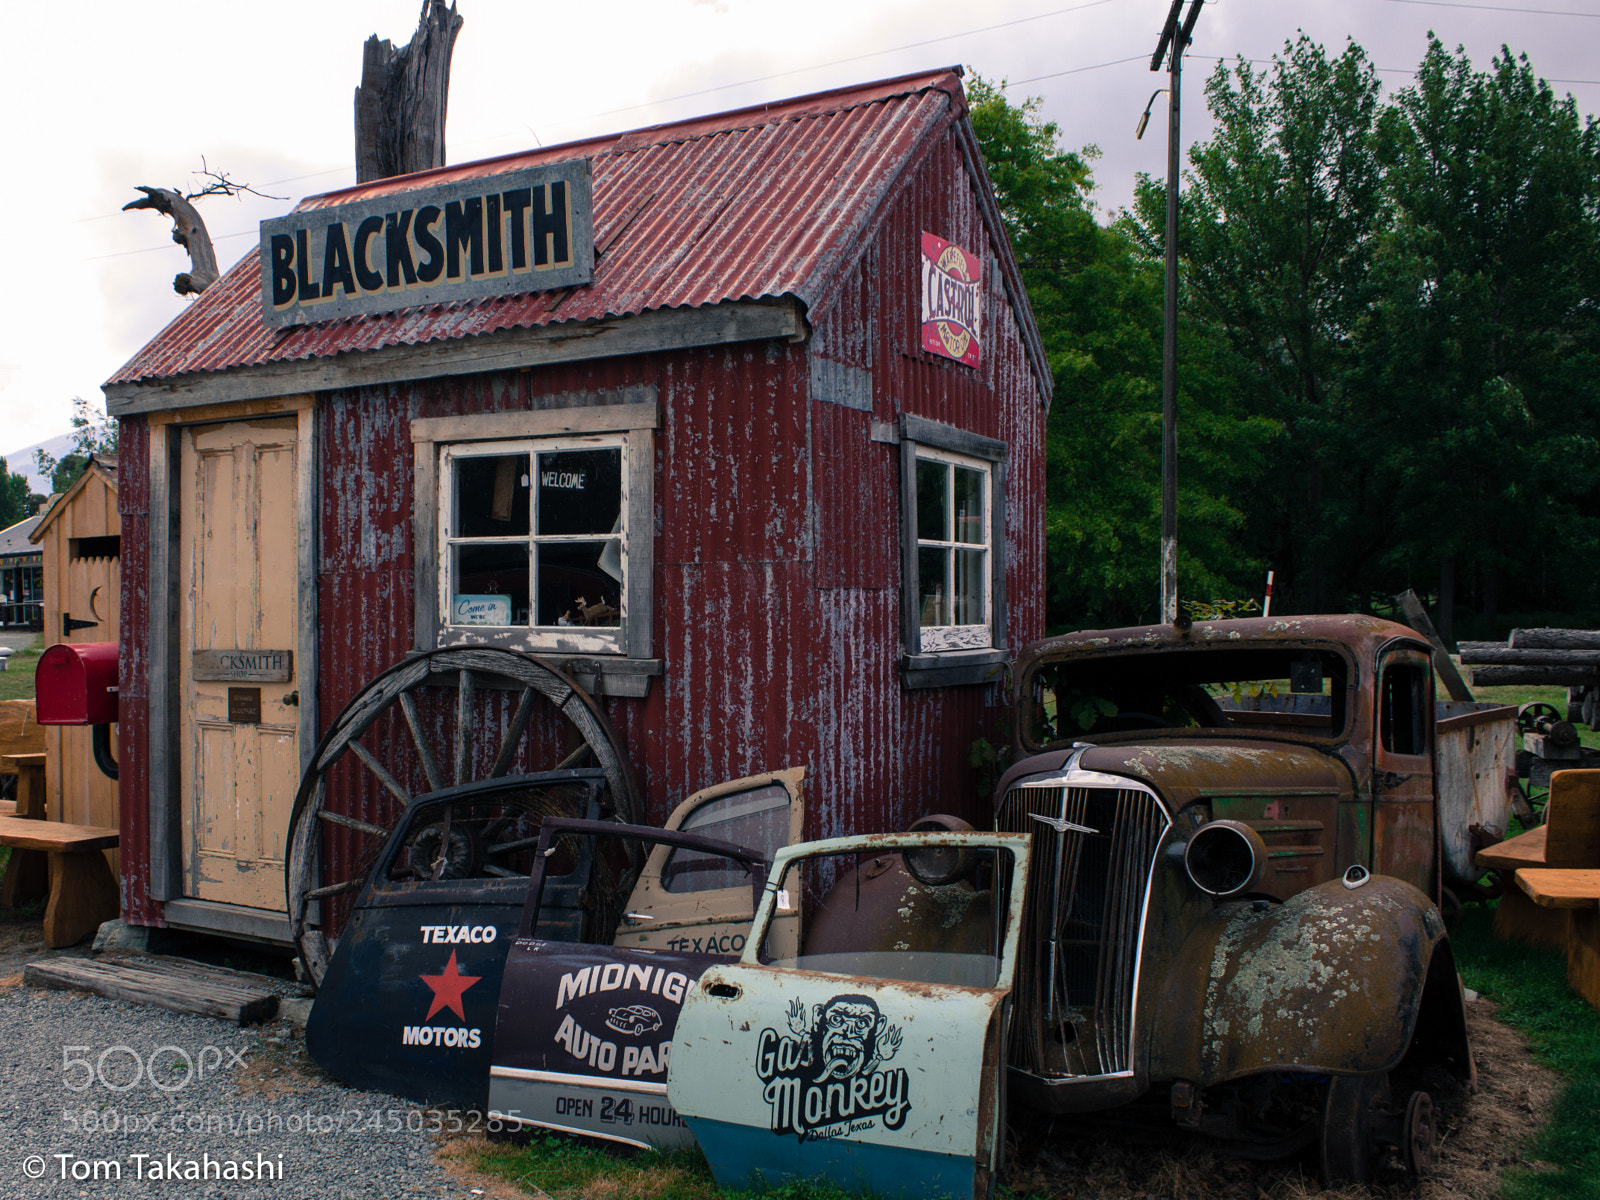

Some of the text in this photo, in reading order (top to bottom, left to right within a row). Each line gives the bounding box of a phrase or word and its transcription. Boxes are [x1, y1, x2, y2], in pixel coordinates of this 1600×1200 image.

[271, 180, 573, 310] BLACKSMITH
[928, 265, 977, 338] CASTROL
[541, 471, 586, 490] WELCOME
[458, 599, 497, 616] Come in
[198, 655, 282, 670] CKSMITH
[420, 925, 497, 944] TEXACO
[667, 934, 746, 954] TEXACO
[403, 1026, 482, 1049] MOTORS
[554, 1013, 617, 1072] AUTO
[756, 1027, 814, 1082] Gas
[556, 1096, 593, 1118] OPEN
[600, 1096, 635, 1126] 24
[763, 1068, 912, 1143] Monkey
[807, 1119, 876, 1142] Dallas Texas
